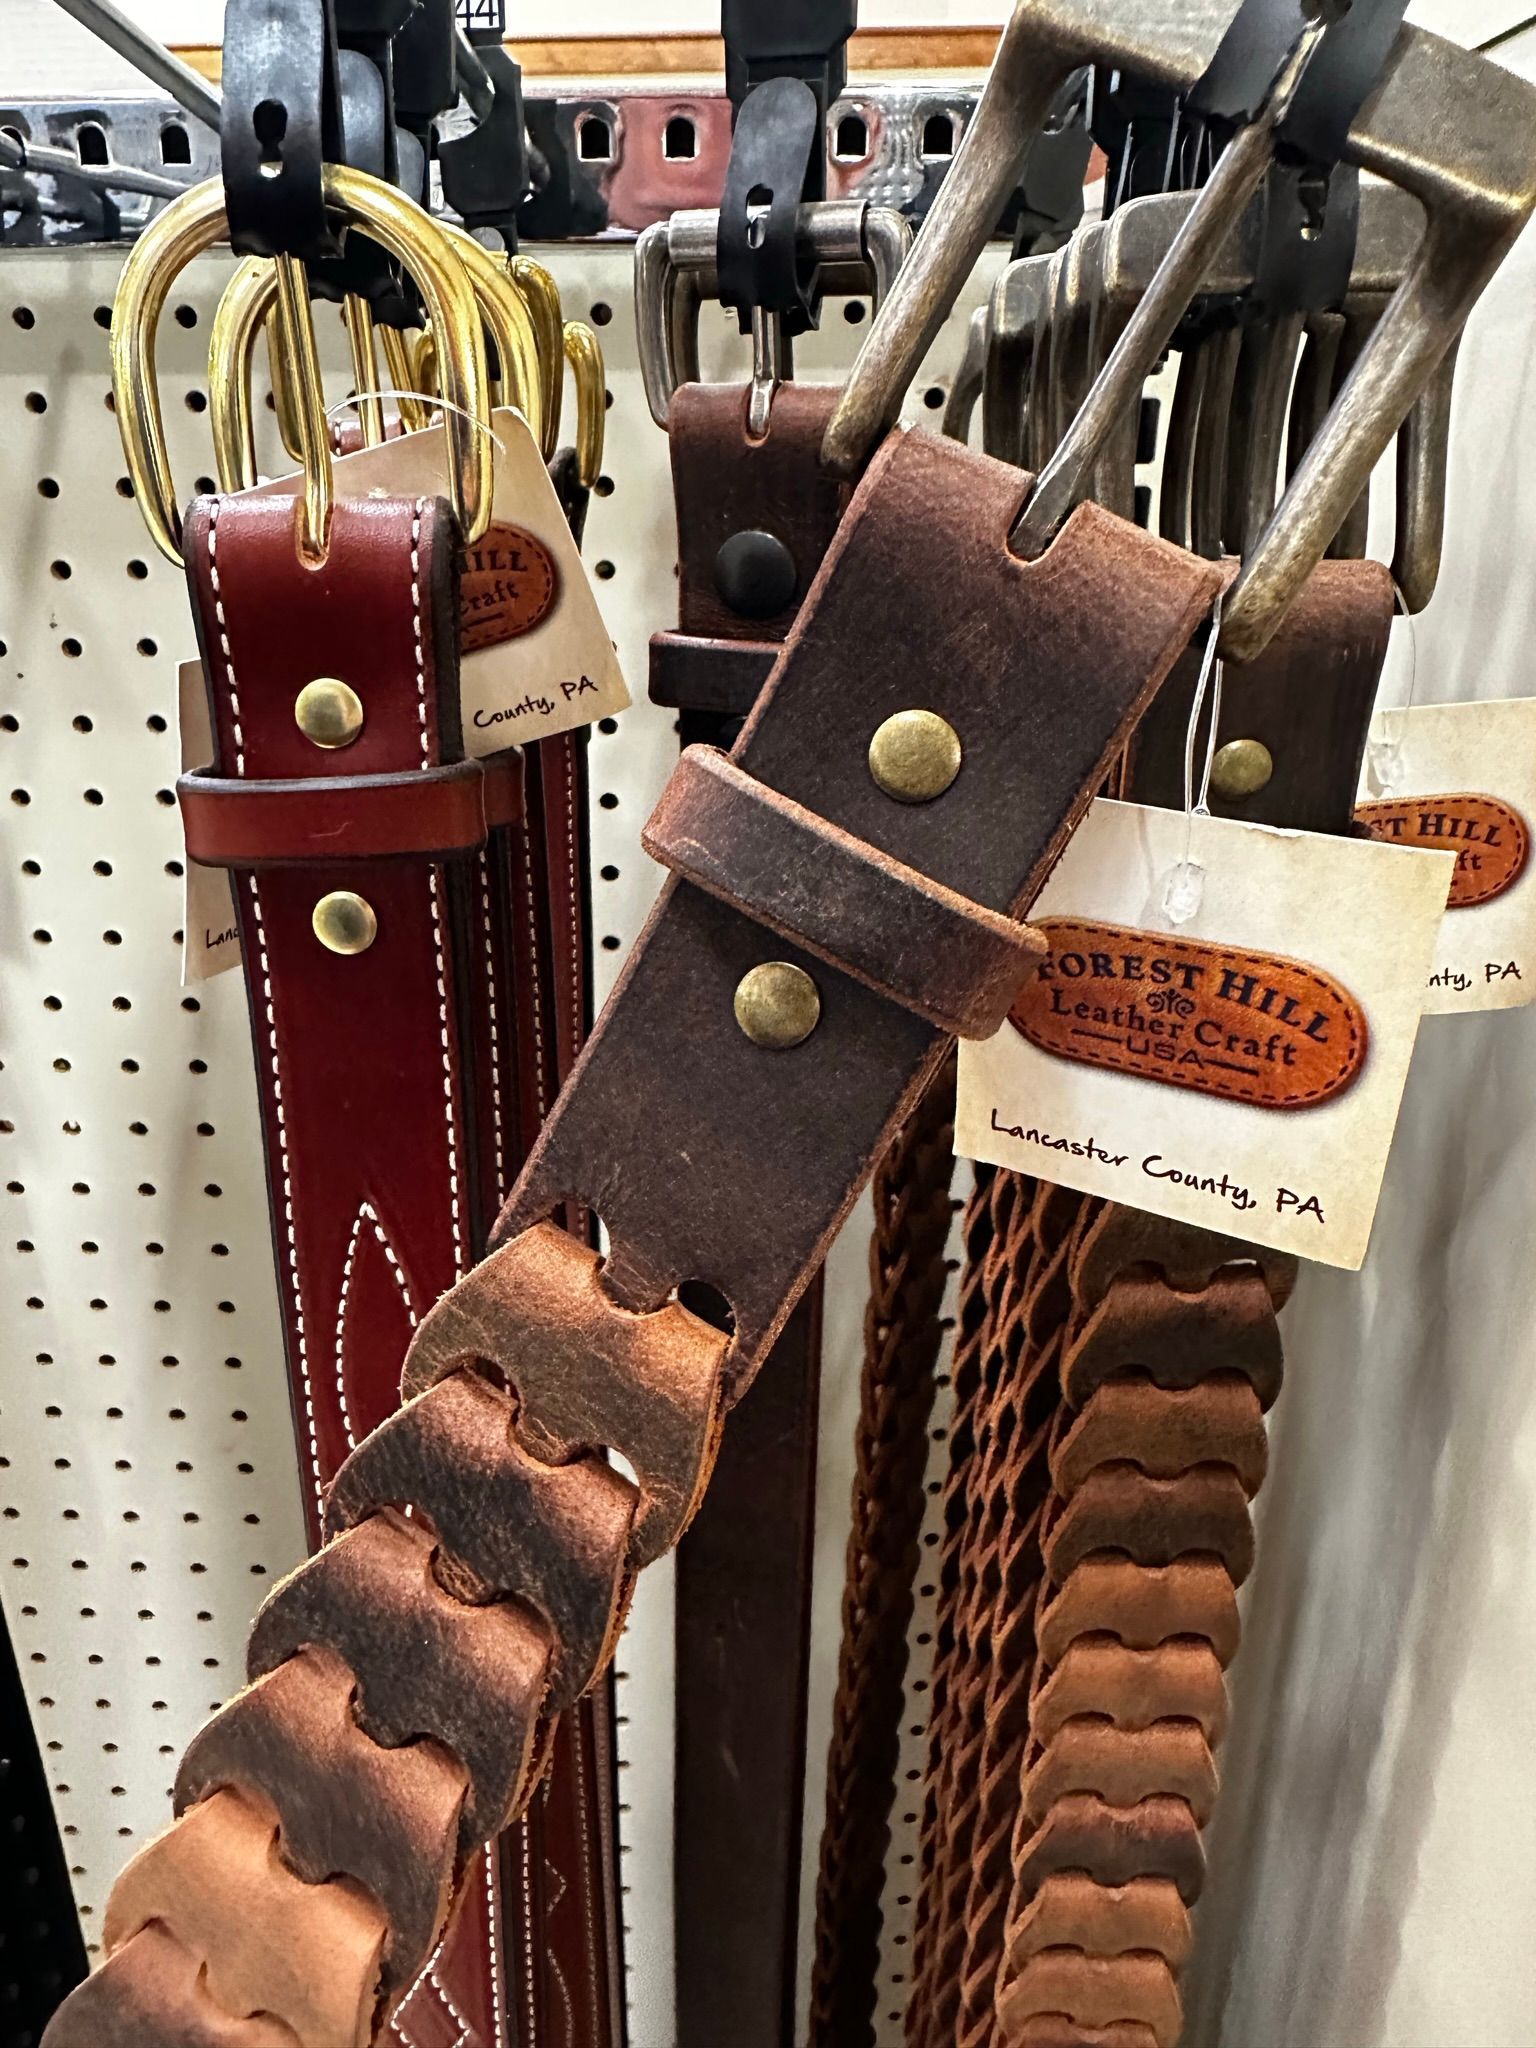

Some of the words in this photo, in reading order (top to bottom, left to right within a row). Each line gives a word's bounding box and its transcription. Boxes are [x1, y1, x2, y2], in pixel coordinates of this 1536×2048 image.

[473, 695, 555, 729] County,
[560, 675, 598, 701] PA
[1417, 813, 1502, 847] HILL
[1038, 951, 1205, 991] FOREST
[1215, 968, 1330, 1043] HILL
[1426, 967, 1472, 991] nty,
[1484, 961, 1522, 983] PA
[1050, 988, 1184, 1040] Leather
[1194, 1020, 1297, 1066] Craft
[1126, 1034, 1204, 1069] USA
[991, 1108, 1129, 1168] Lancaster
[1142, 1154, 1257, 1210] County,
[1275, 1187, 1325, 1224] PA
